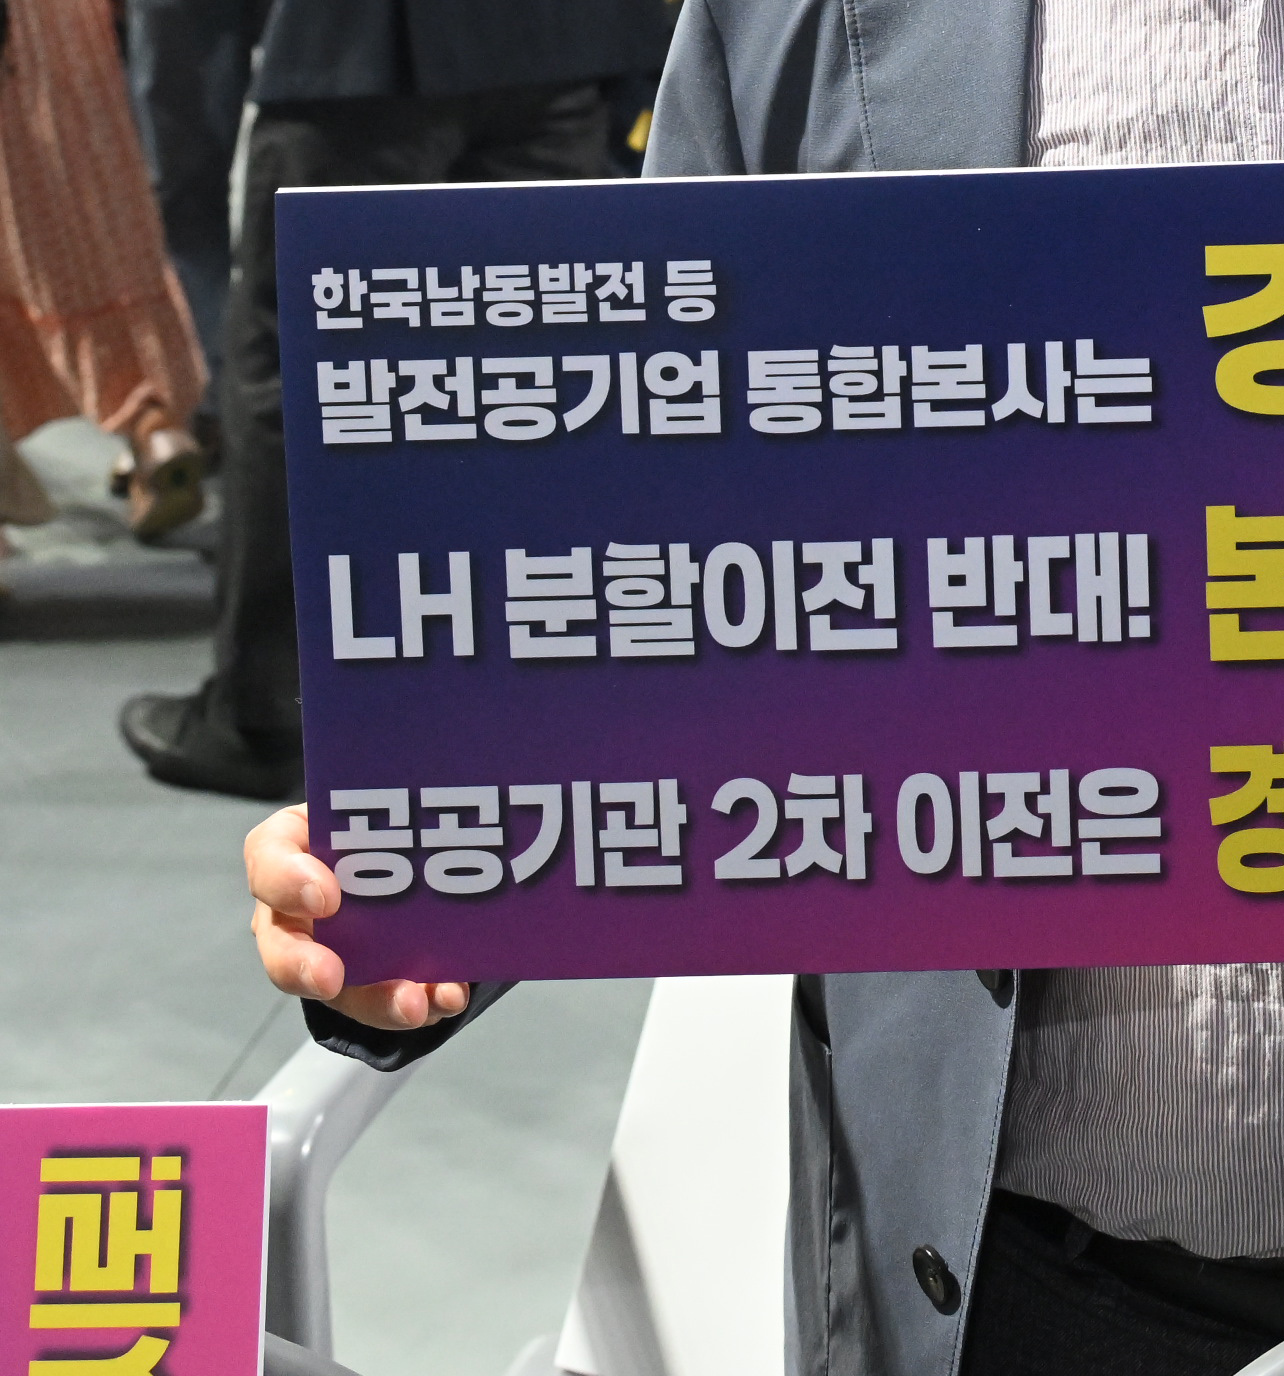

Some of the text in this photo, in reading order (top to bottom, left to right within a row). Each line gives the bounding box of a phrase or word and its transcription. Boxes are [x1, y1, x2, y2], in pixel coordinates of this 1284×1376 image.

[312, 260, 716, 329] 한국남동발전 등
[317, 350, 721, 443] 발전공기업
[747, 339, 1152, 433] 통합본사는
[329, 552, 474, 659] LH
[505, 538, 897, 658] 분할이전
[927, 532, 1150, 647] 반대!
[330, 779, 686, 896] 공공기관
[711, 773, 872, 879] 2차
[897, 768, 1161, 877] 이전은
